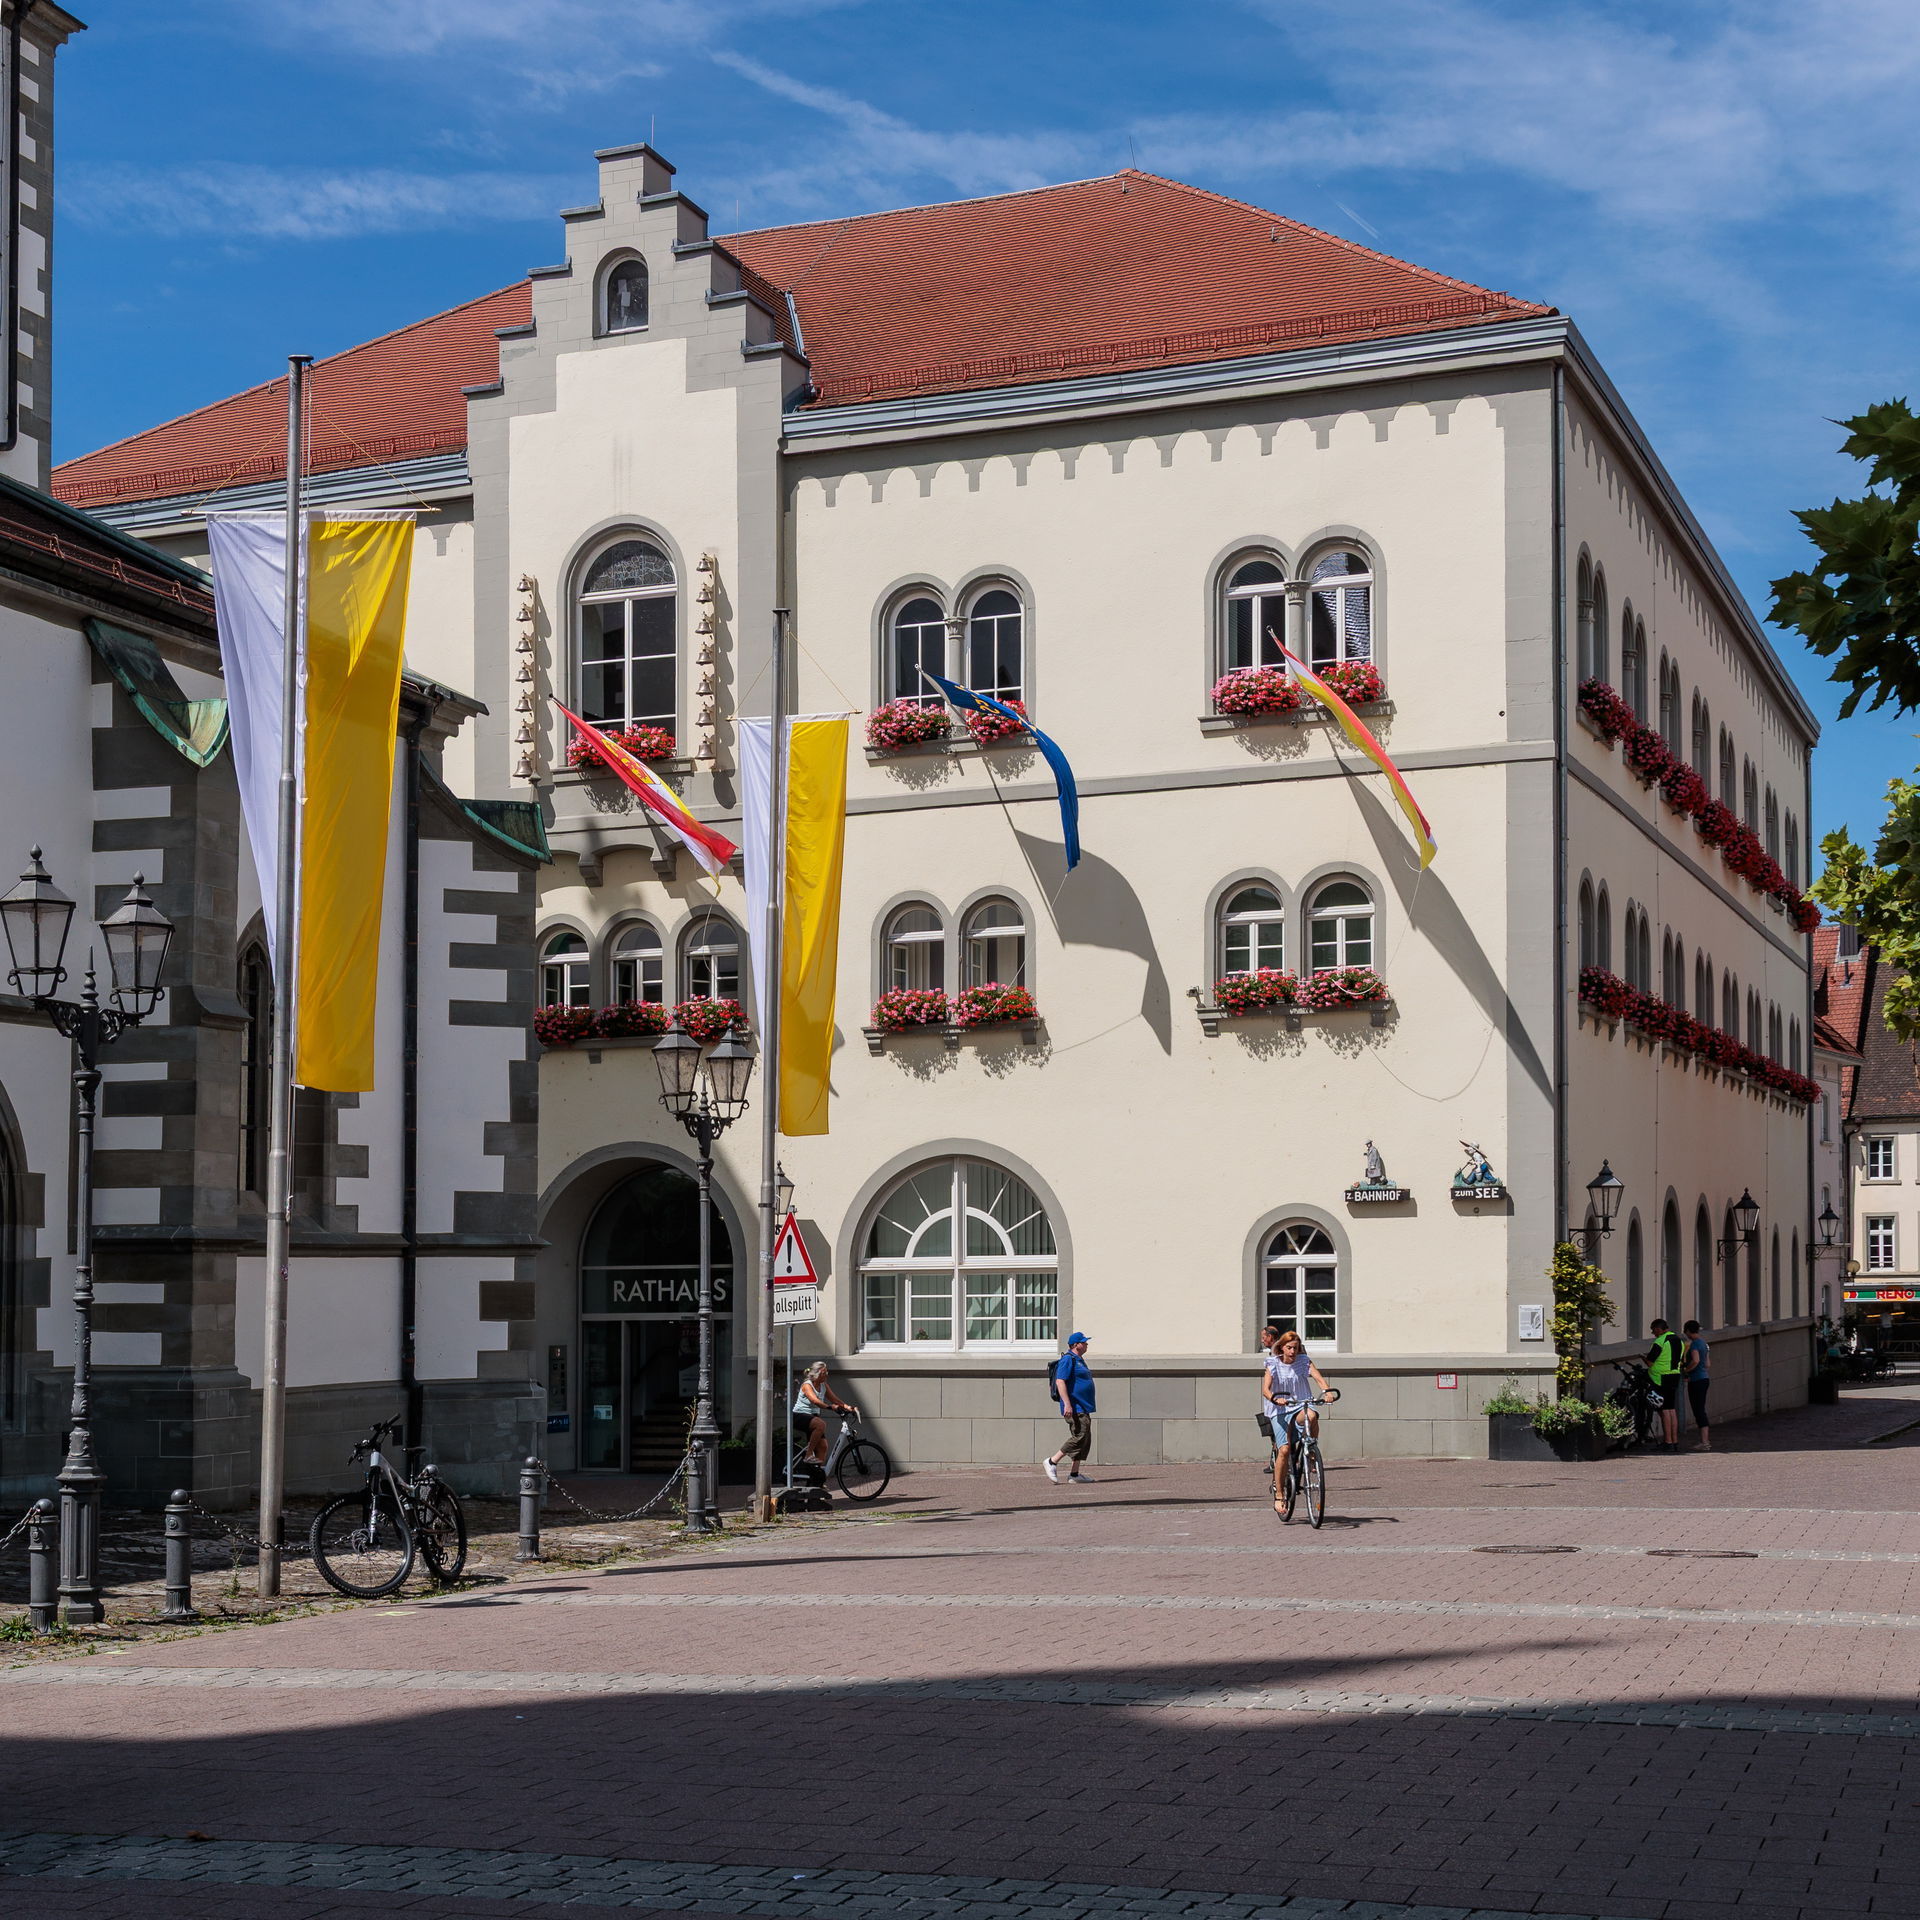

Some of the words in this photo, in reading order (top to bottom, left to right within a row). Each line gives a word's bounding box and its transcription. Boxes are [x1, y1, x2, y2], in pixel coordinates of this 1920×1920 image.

[1354, 1189, 1402, 1202] BAHNHOF
[1475, 1187, 1500, 1199] SEE
[1876, 1289, 1915, 1300] RENO
[774, 1295, 812, 1316] ollsplitt
